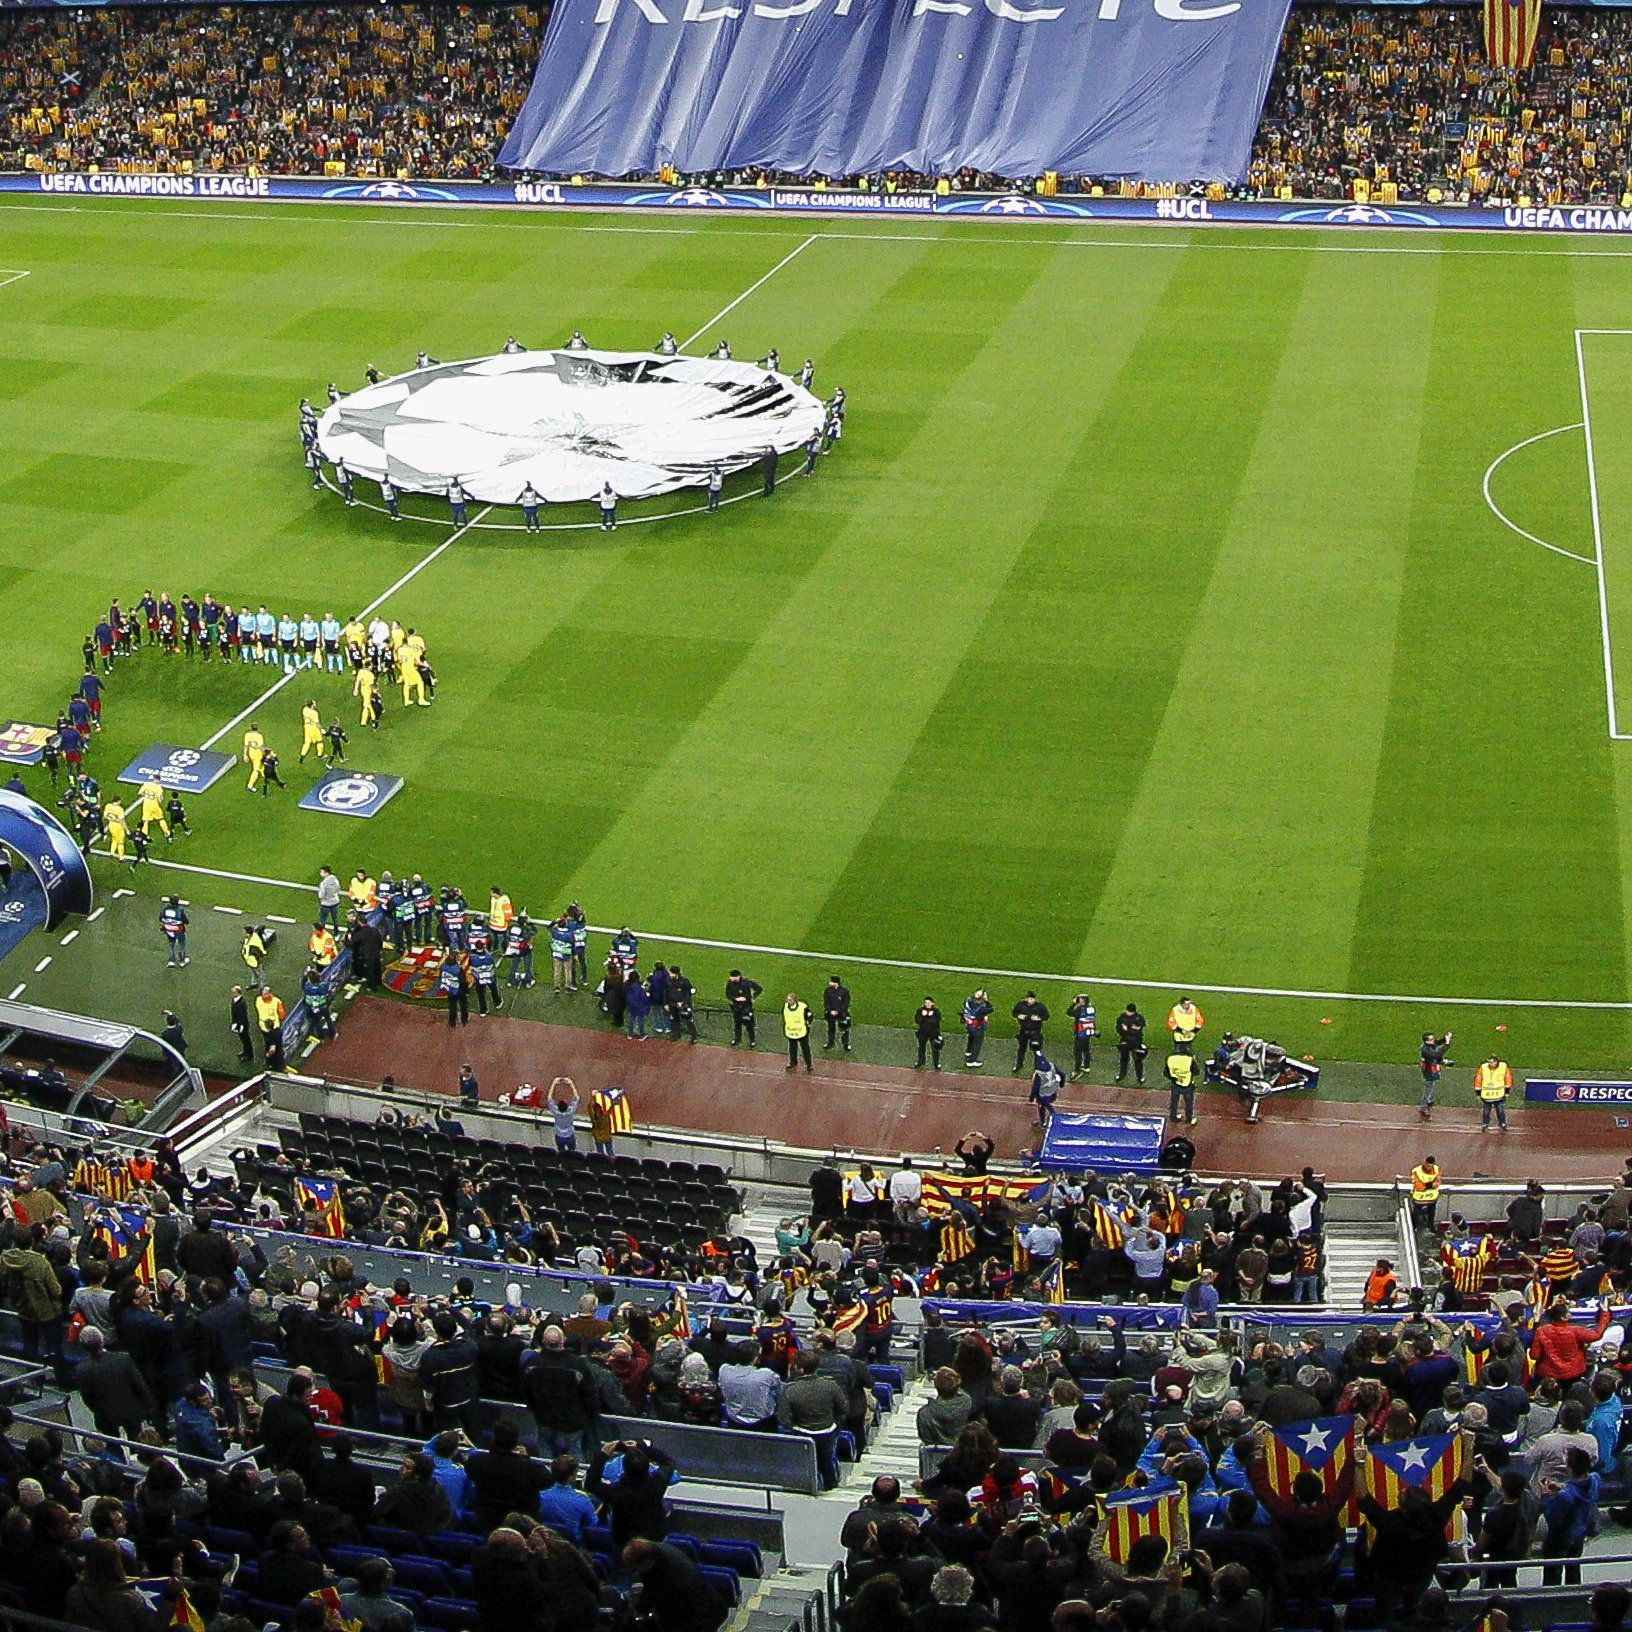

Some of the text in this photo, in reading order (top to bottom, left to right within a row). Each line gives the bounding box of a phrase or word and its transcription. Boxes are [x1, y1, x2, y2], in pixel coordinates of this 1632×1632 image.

[40, 174, 270, 197] UEFA CHAMPIONS LEAGUE
[515, 184, 566, 204] #UCL
[776, 193, 931, 210] UEFA CHAMPIONS LEAGUE
[1155, 199, 1213, 220] #UCL
[1503, 207, 1567, 228] UEFA
